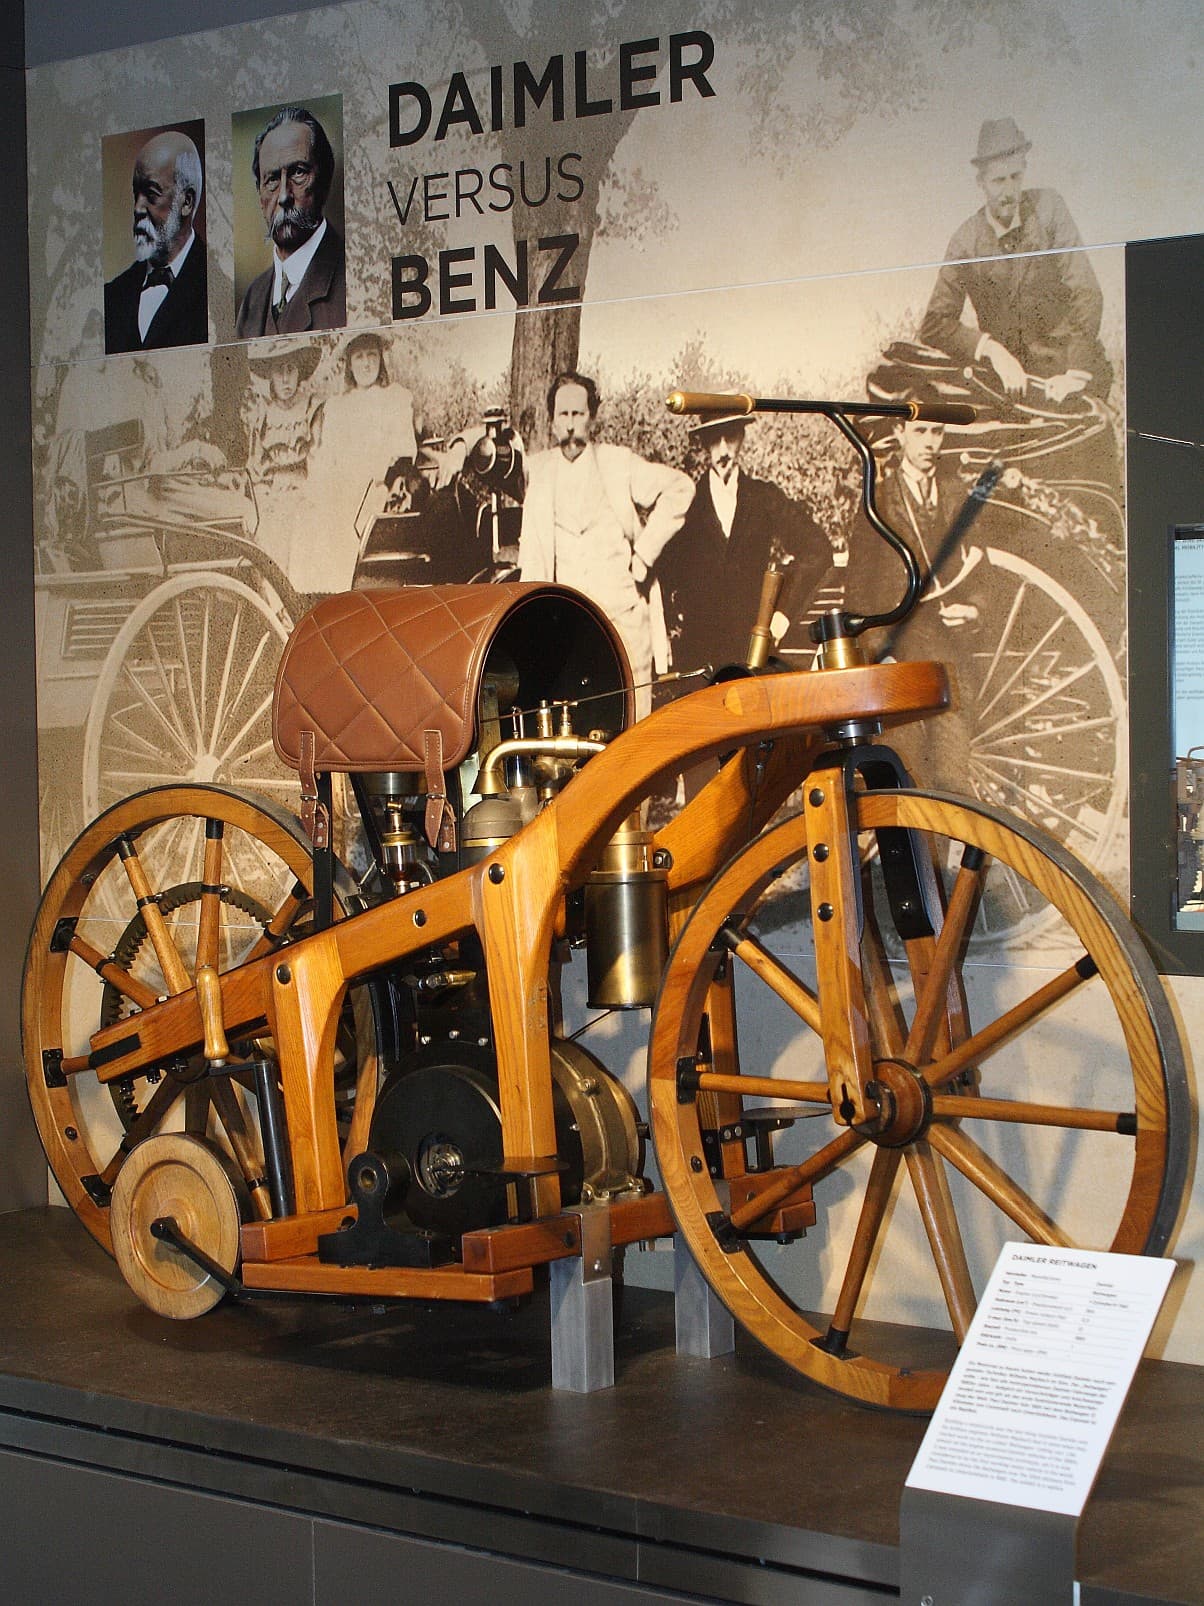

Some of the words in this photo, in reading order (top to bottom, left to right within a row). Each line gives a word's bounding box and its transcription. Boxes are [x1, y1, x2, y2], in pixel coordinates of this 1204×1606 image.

[388, 30, 717, 148] DAIMLER
[387, 152, 584, 226] VERSUS
[391, 233, 582, 321] BENZ
[1011, 1253, 1047, 1265] DAIMLER
[1048, 1258, 1098, 1270] REITWAGEN
